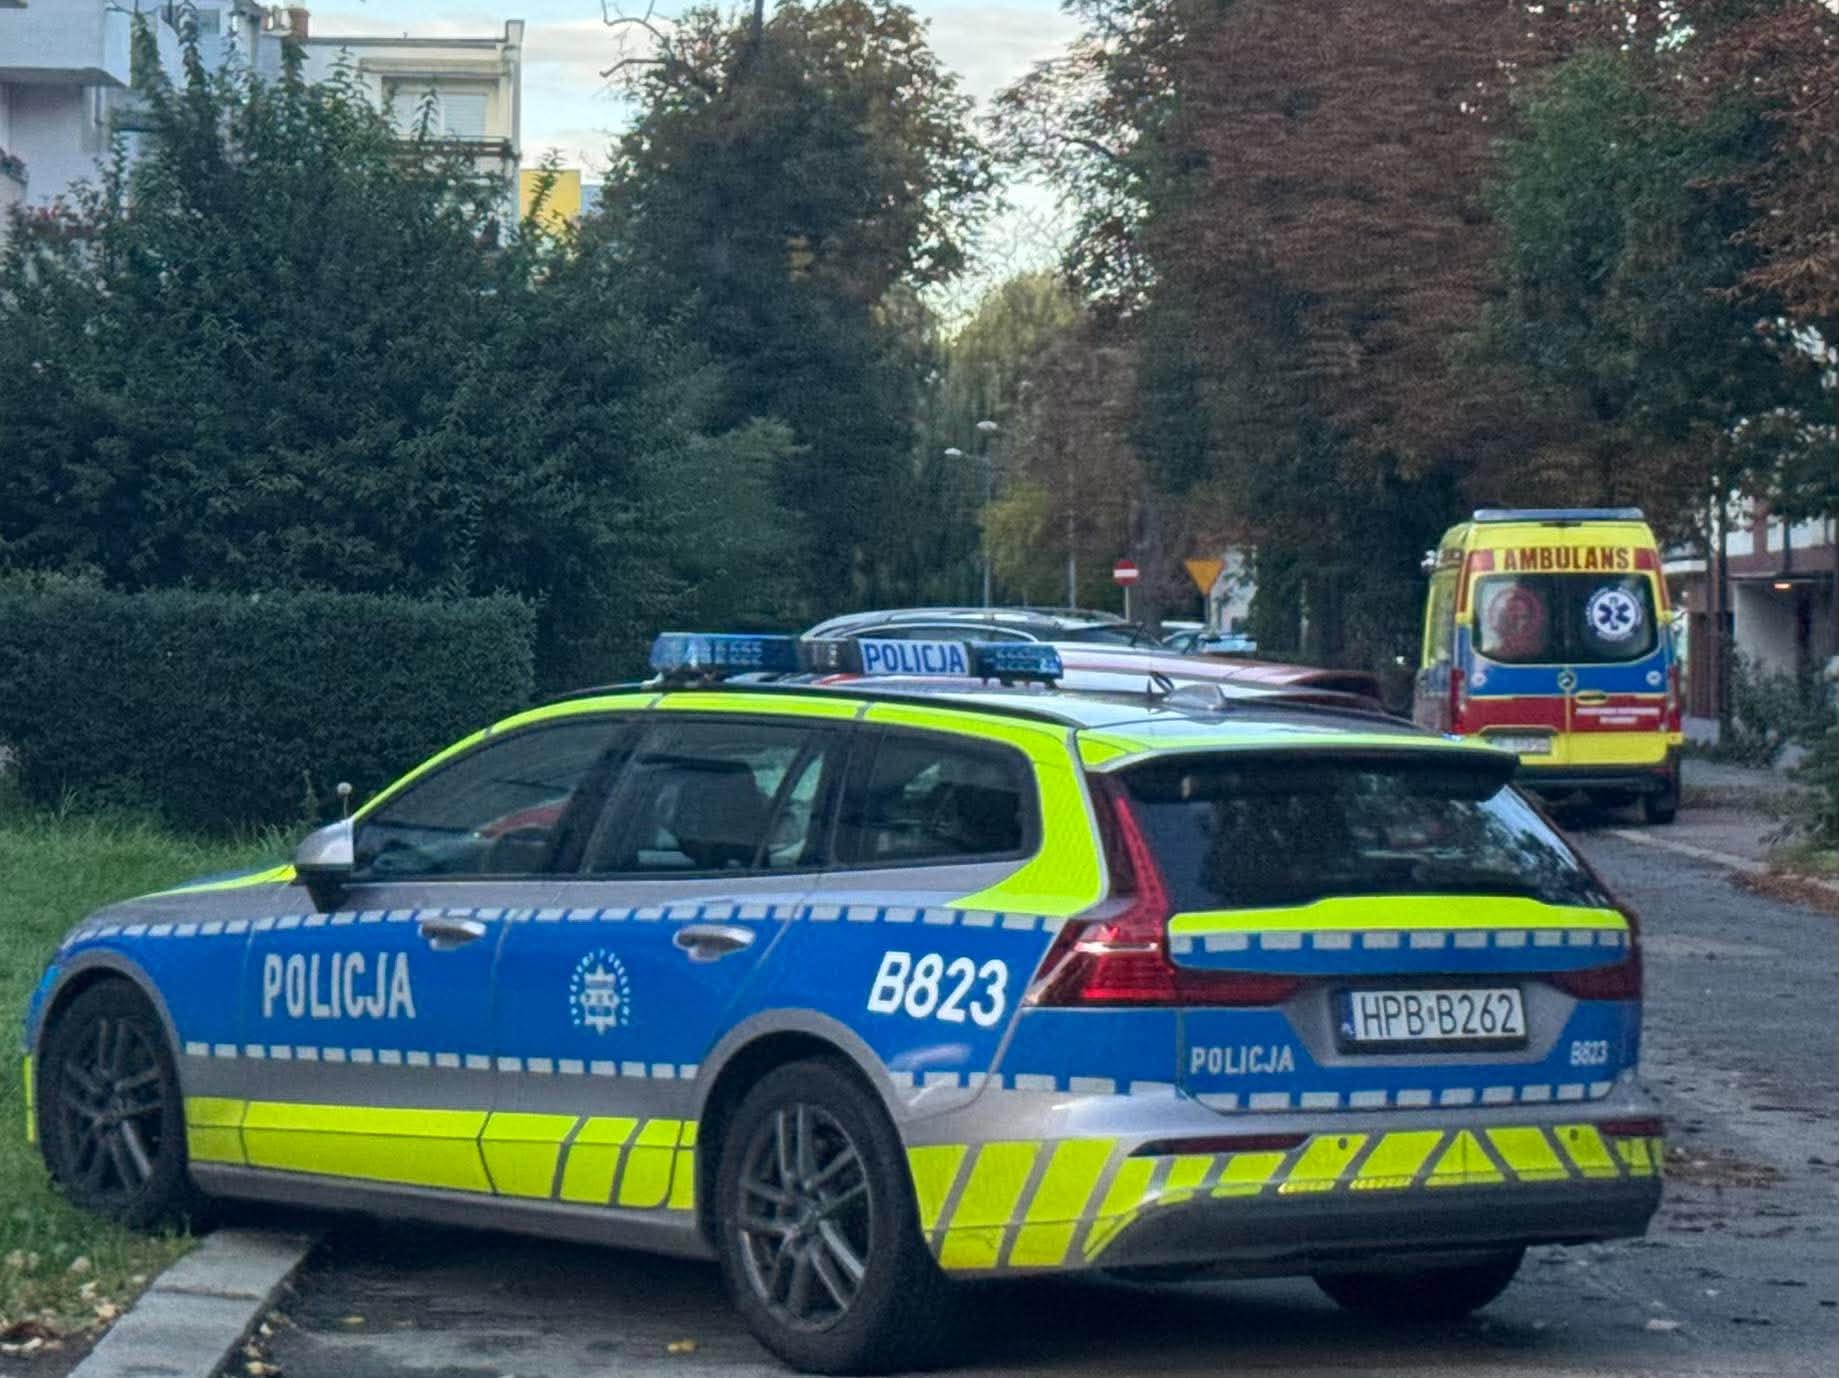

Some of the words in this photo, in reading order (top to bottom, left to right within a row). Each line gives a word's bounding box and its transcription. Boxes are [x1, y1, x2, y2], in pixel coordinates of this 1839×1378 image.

[1503, 546, 1630, 570] AMBULANS
[864, 642, 966, 672] POLICJA
[263, 952, 416, 1019] POLICJA
[867, 951, 1008, 1027] B823
[1361, 995, 1425, 1036] HPB
[1436, 993, 1517, 1035] B262
[1190, 1045, 1295, 1074] POLICJA
[1571, 1040, 1608, 1066] B823
